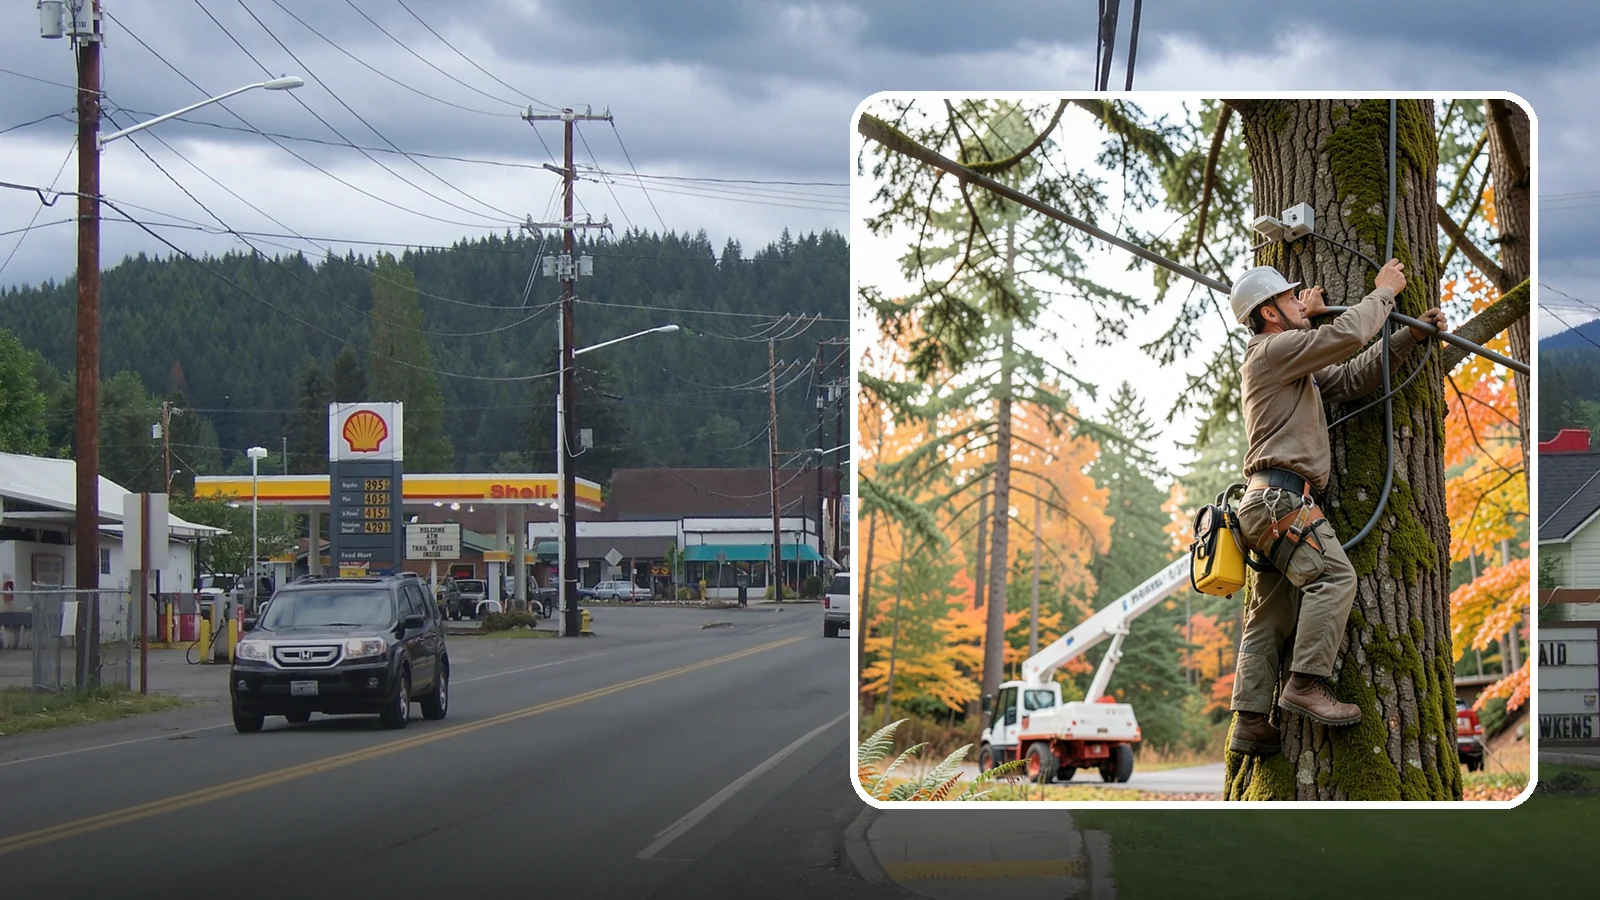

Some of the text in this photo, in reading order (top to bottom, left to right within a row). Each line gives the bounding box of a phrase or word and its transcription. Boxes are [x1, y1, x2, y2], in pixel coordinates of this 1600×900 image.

[366, 480, 384, 490] 395
[490, 484, 548, 498] Shell
[366, 494, 384, 504] 405
[366, 508, 384, 518] 415
[366, 522, 384, 532] 429
